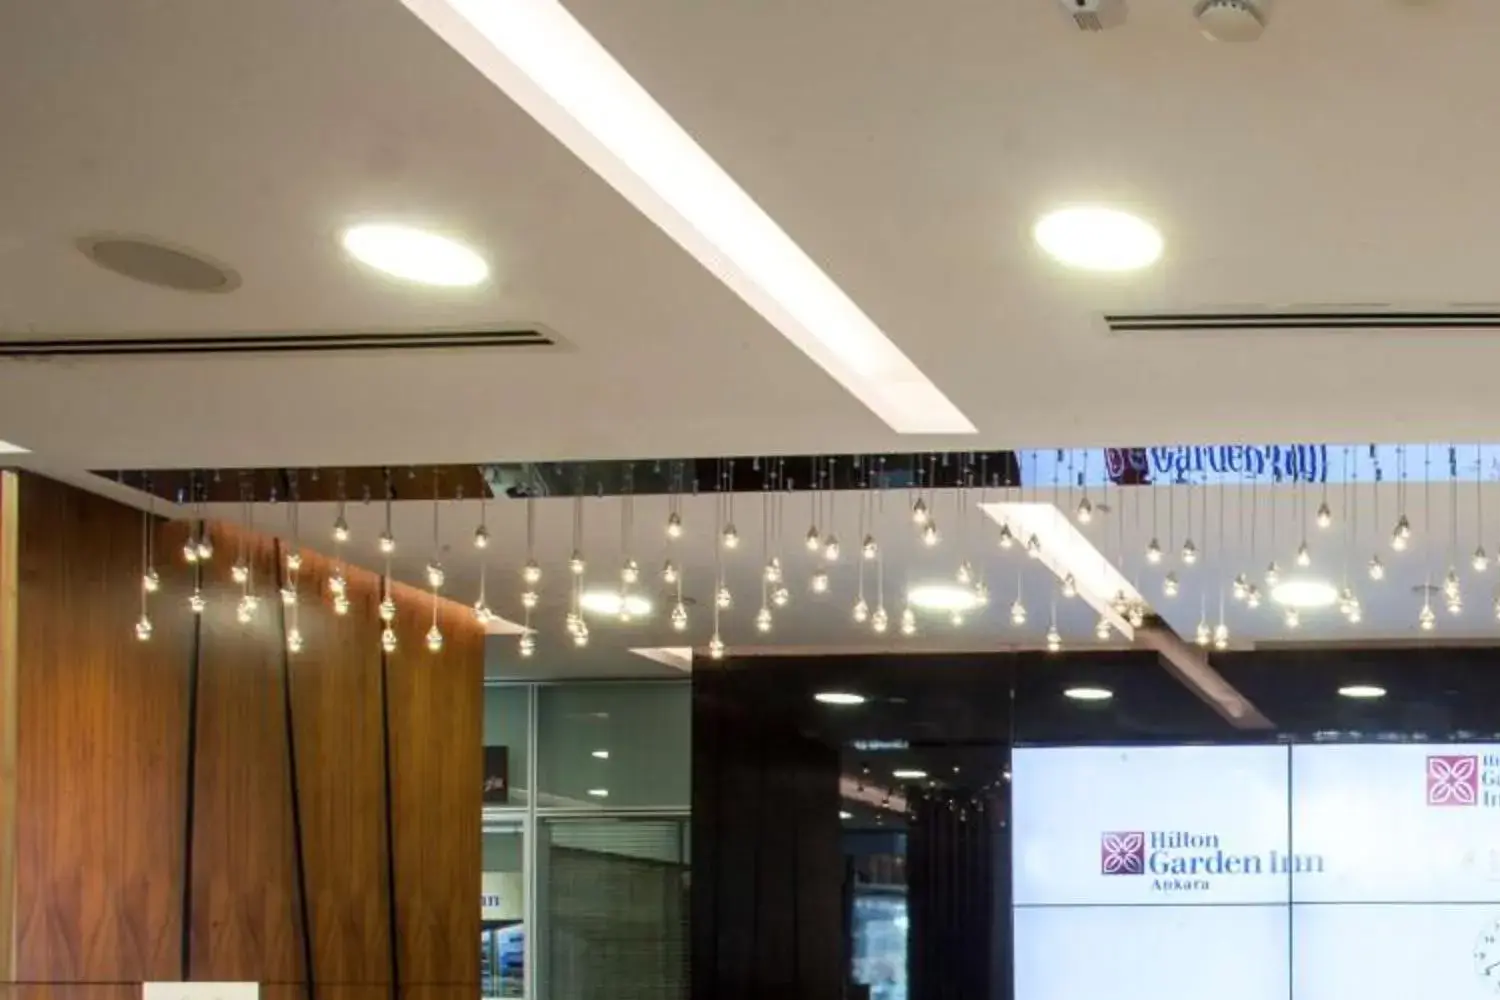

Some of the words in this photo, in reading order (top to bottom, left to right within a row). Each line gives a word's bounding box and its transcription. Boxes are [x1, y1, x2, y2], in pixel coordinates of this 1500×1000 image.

[1150, 830, 1220, 849] Hilton
[1149, 850, 1263, 875] Garden
[1270, 850, 1325, 874] Inn
